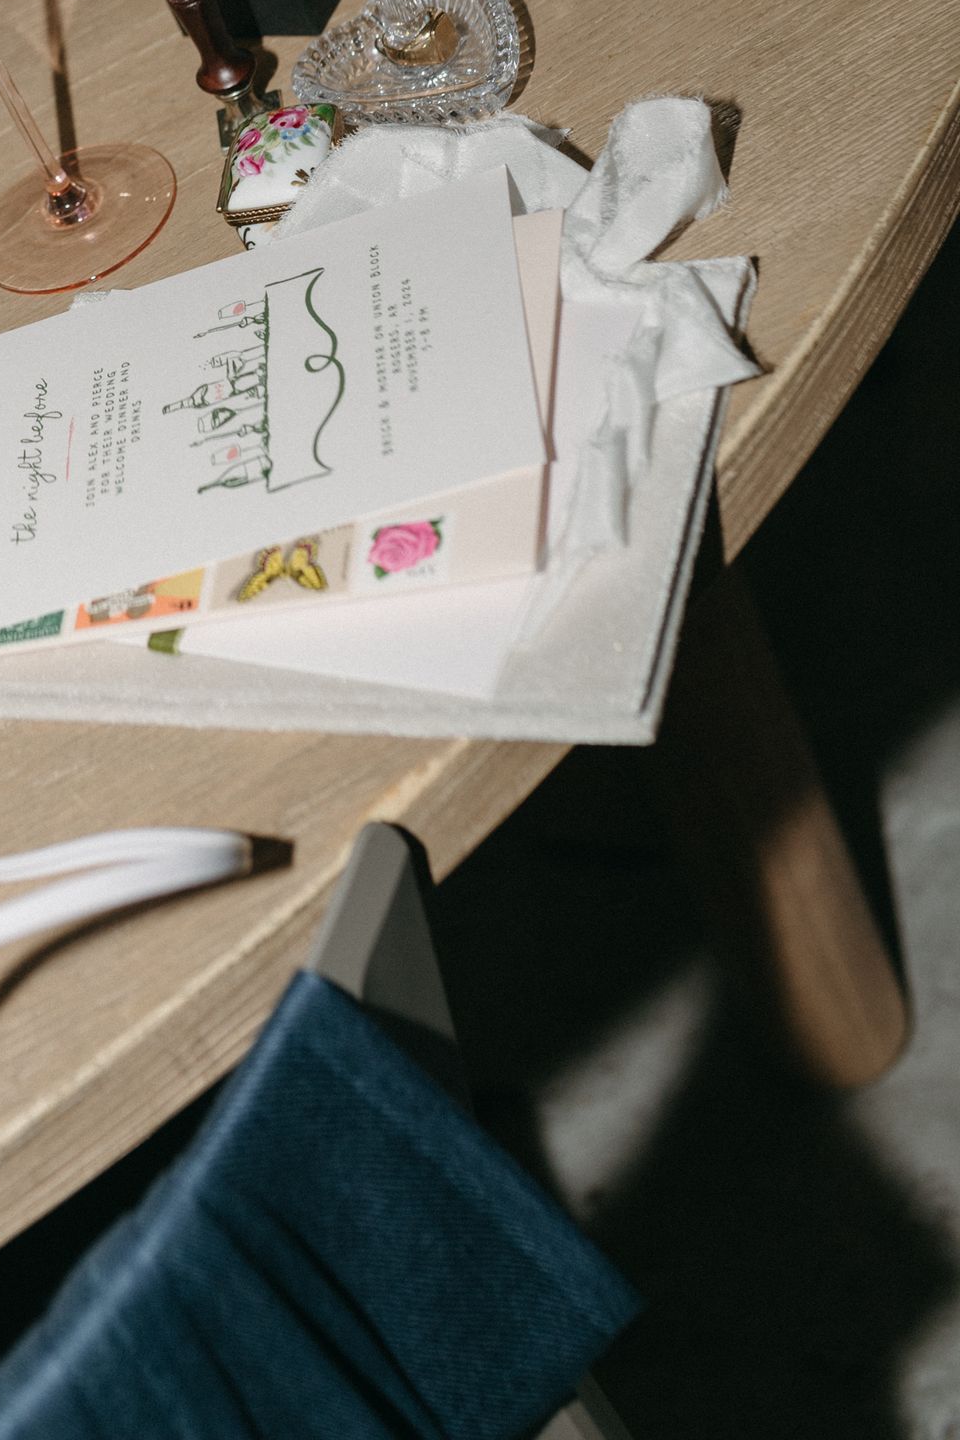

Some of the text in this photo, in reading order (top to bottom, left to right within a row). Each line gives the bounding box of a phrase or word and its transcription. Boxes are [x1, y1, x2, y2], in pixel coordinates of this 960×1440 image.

[369, 244, 381, 279] BLOCK
[371, 283, 383, 319] UNION
[401, 277, 413, 307] 2024
[373, 323, 384, 341] ON
[375, 346, 388, 393] MORTAR
[404, 329, 419, 393] NOVEMBER
[85, 367, 104, 508] JOIN ALEX AND PIERCE
[100, 370, 117, 494] FOR THEIR WEDDING
[114, 361, 131, 496] WELCOME DINNER AND
[130, 399, 142, 444] DRINKS
[10, 377, 63, 545] the night before
